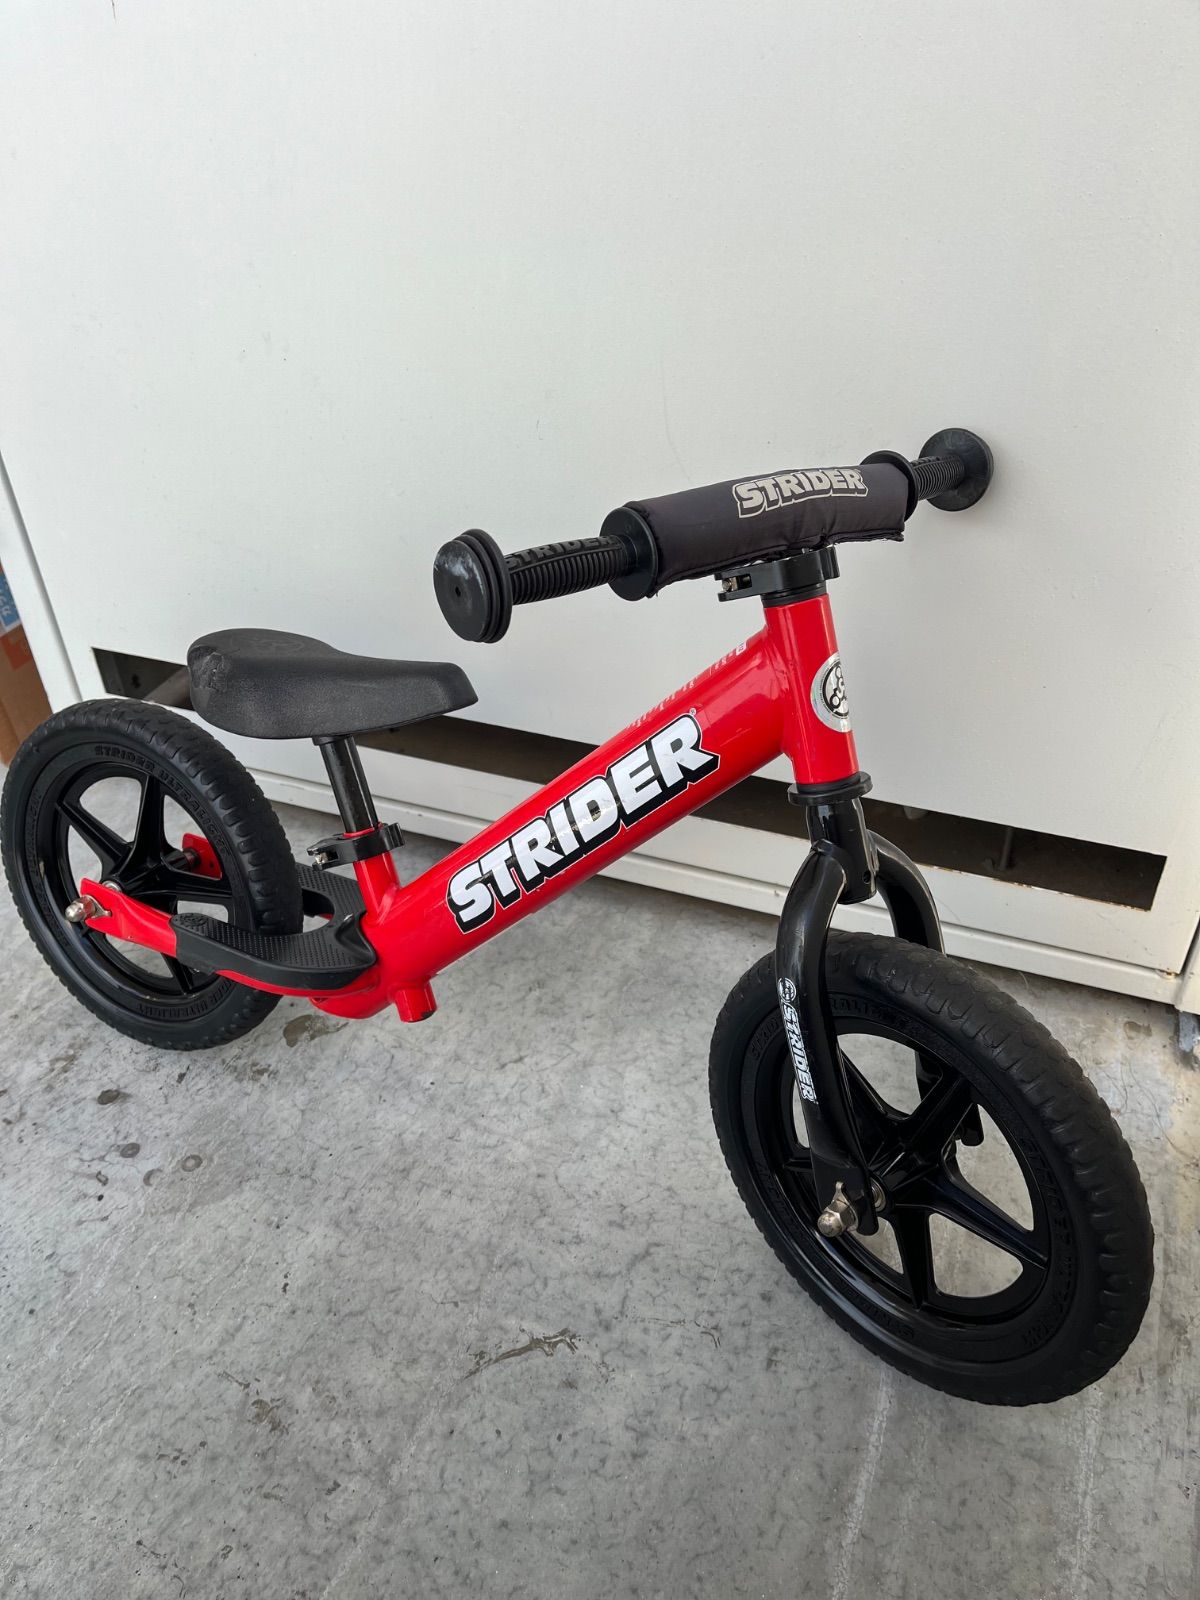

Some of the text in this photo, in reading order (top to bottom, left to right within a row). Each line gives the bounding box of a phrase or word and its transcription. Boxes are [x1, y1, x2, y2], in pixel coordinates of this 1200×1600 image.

[732, 468, 868, 518] STRIDER
[94, 744, 156, 774] STRIDER
[446, 713, 720, 934] STRIDER
[781, 1002, 817, 1103] STRIDER
